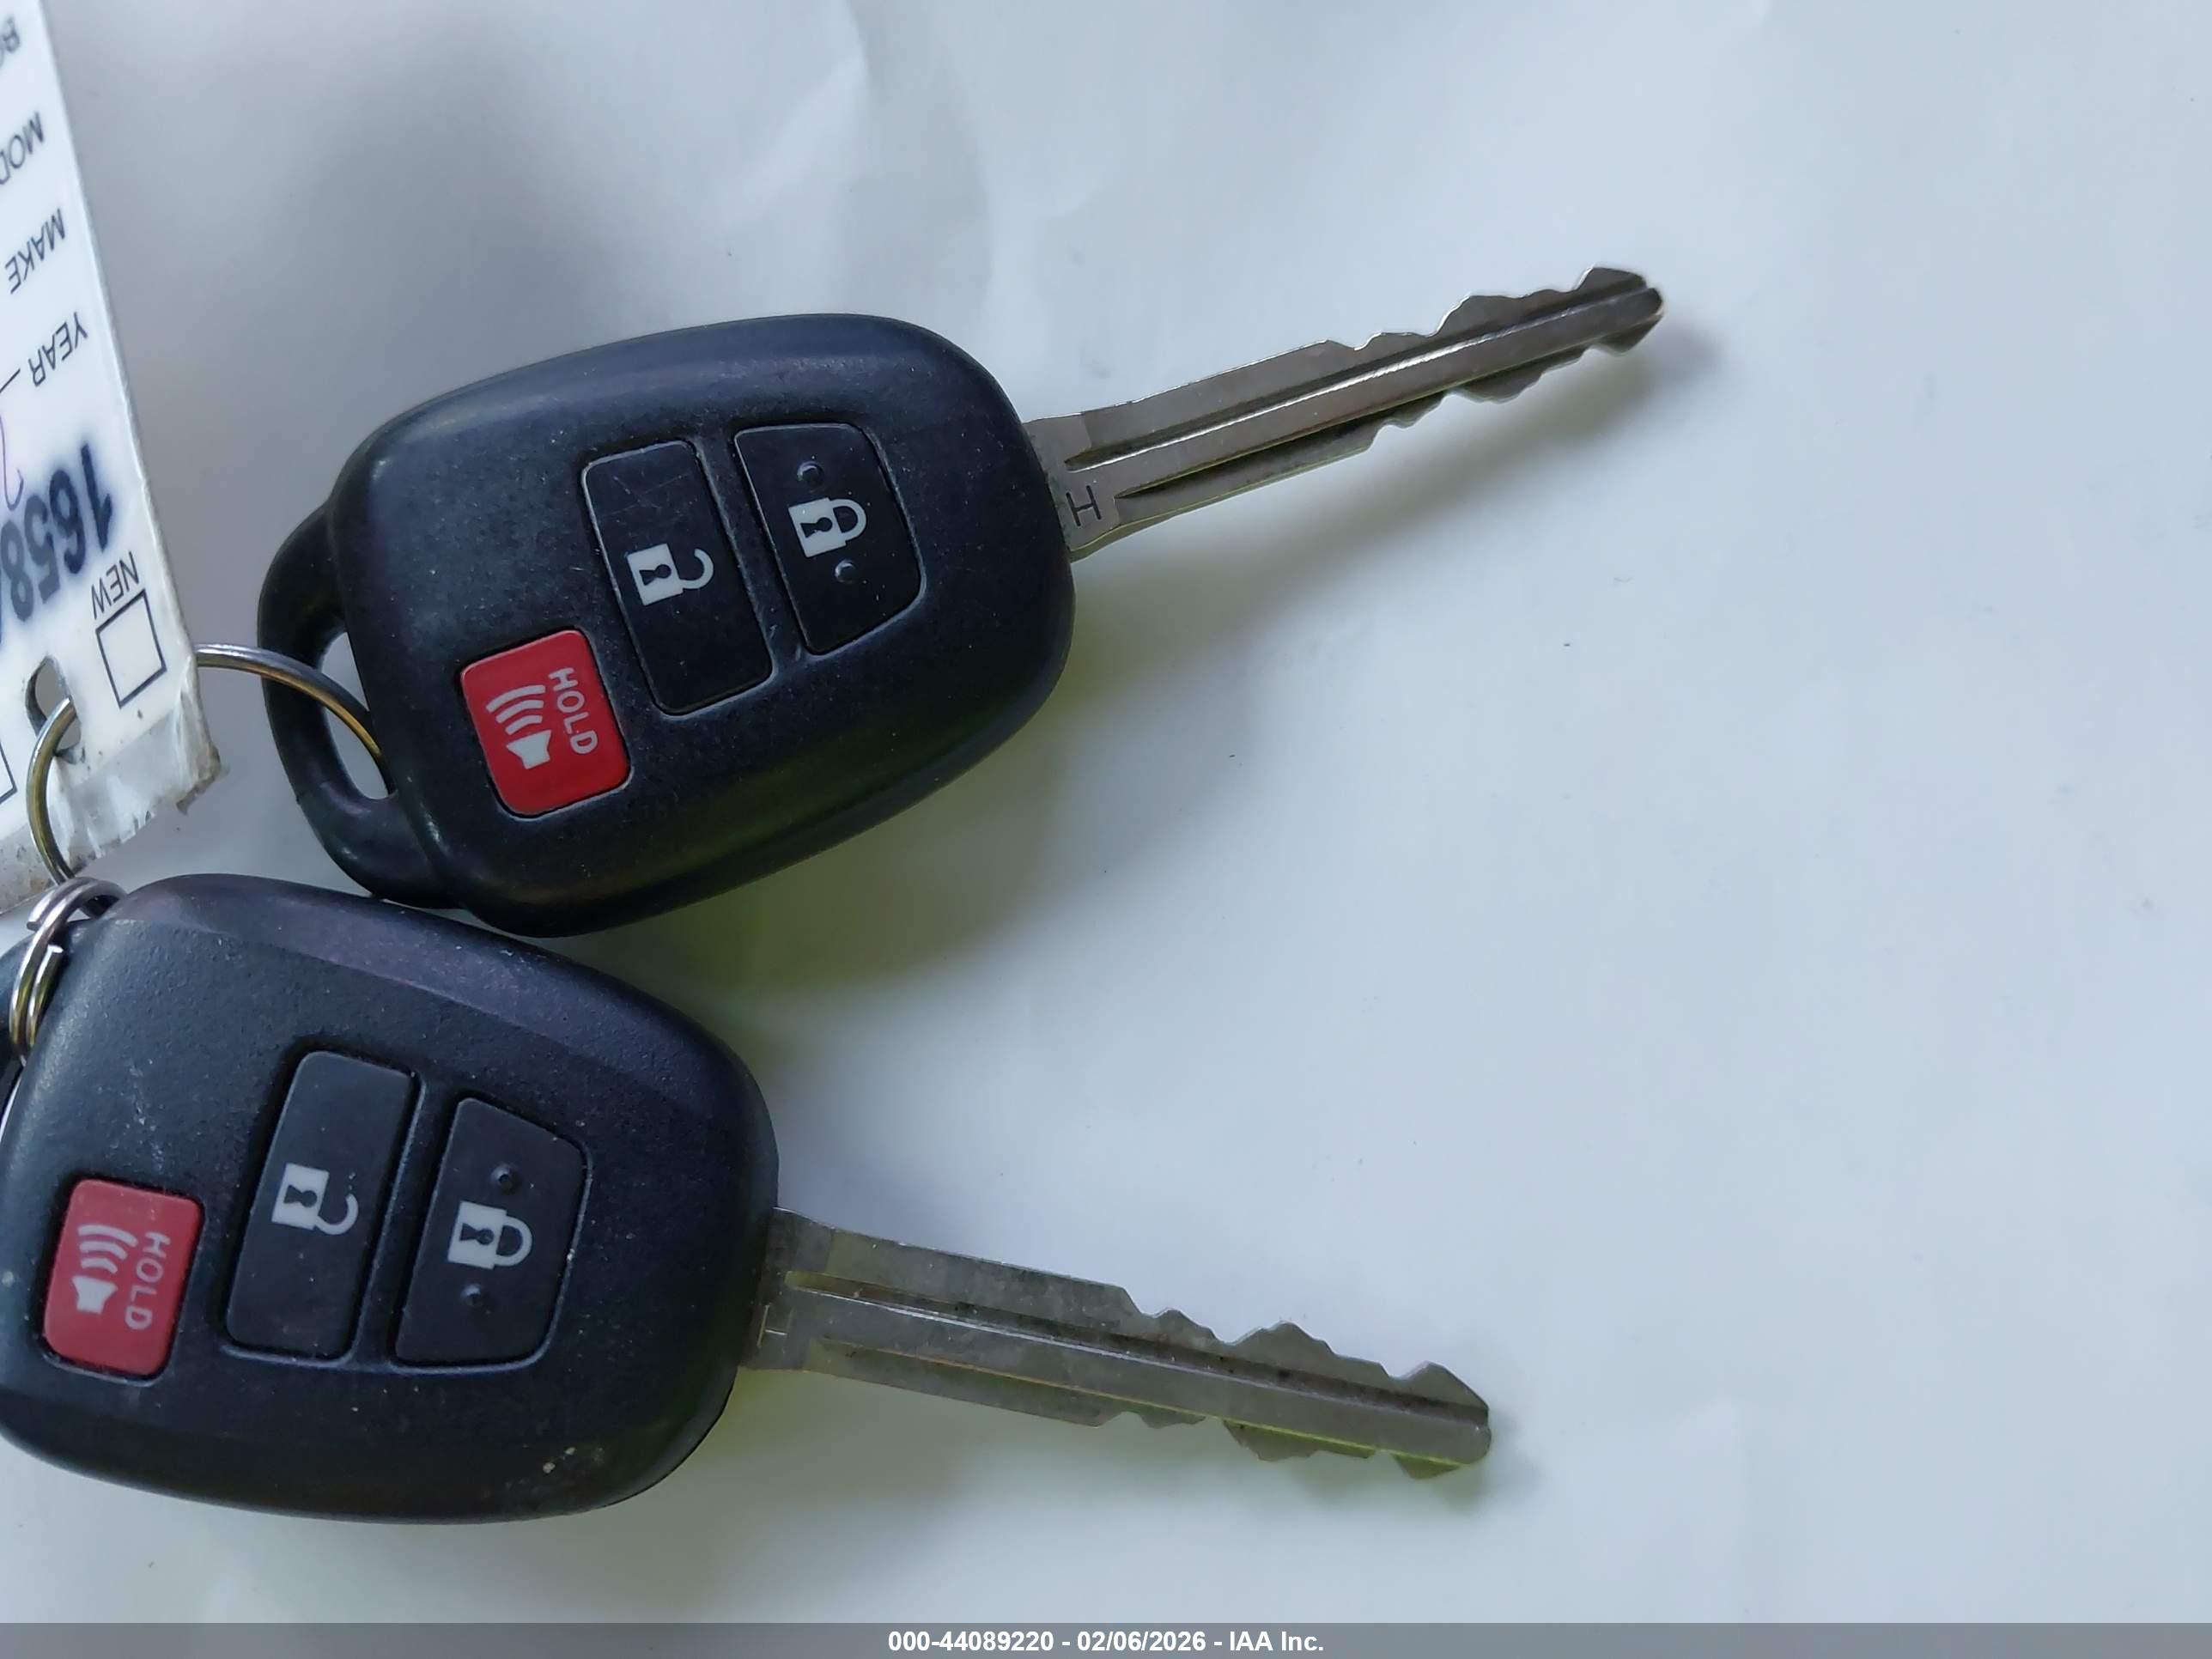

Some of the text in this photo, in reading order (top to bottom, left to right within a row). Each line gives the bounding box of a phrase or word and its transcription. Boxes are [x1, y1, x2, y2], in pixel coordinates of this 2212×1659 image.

[4, 208, 66, 295] MAKE
[27, 312, 88, 387] YEAR
[0, 441, 113, 624] 1658
[1066, 484, 1102, 527] H
[91, 550, 140, 620] NEW
[548, 666, 599, 755] HOLD
[124, 1231, 171, 1330] HOLD
